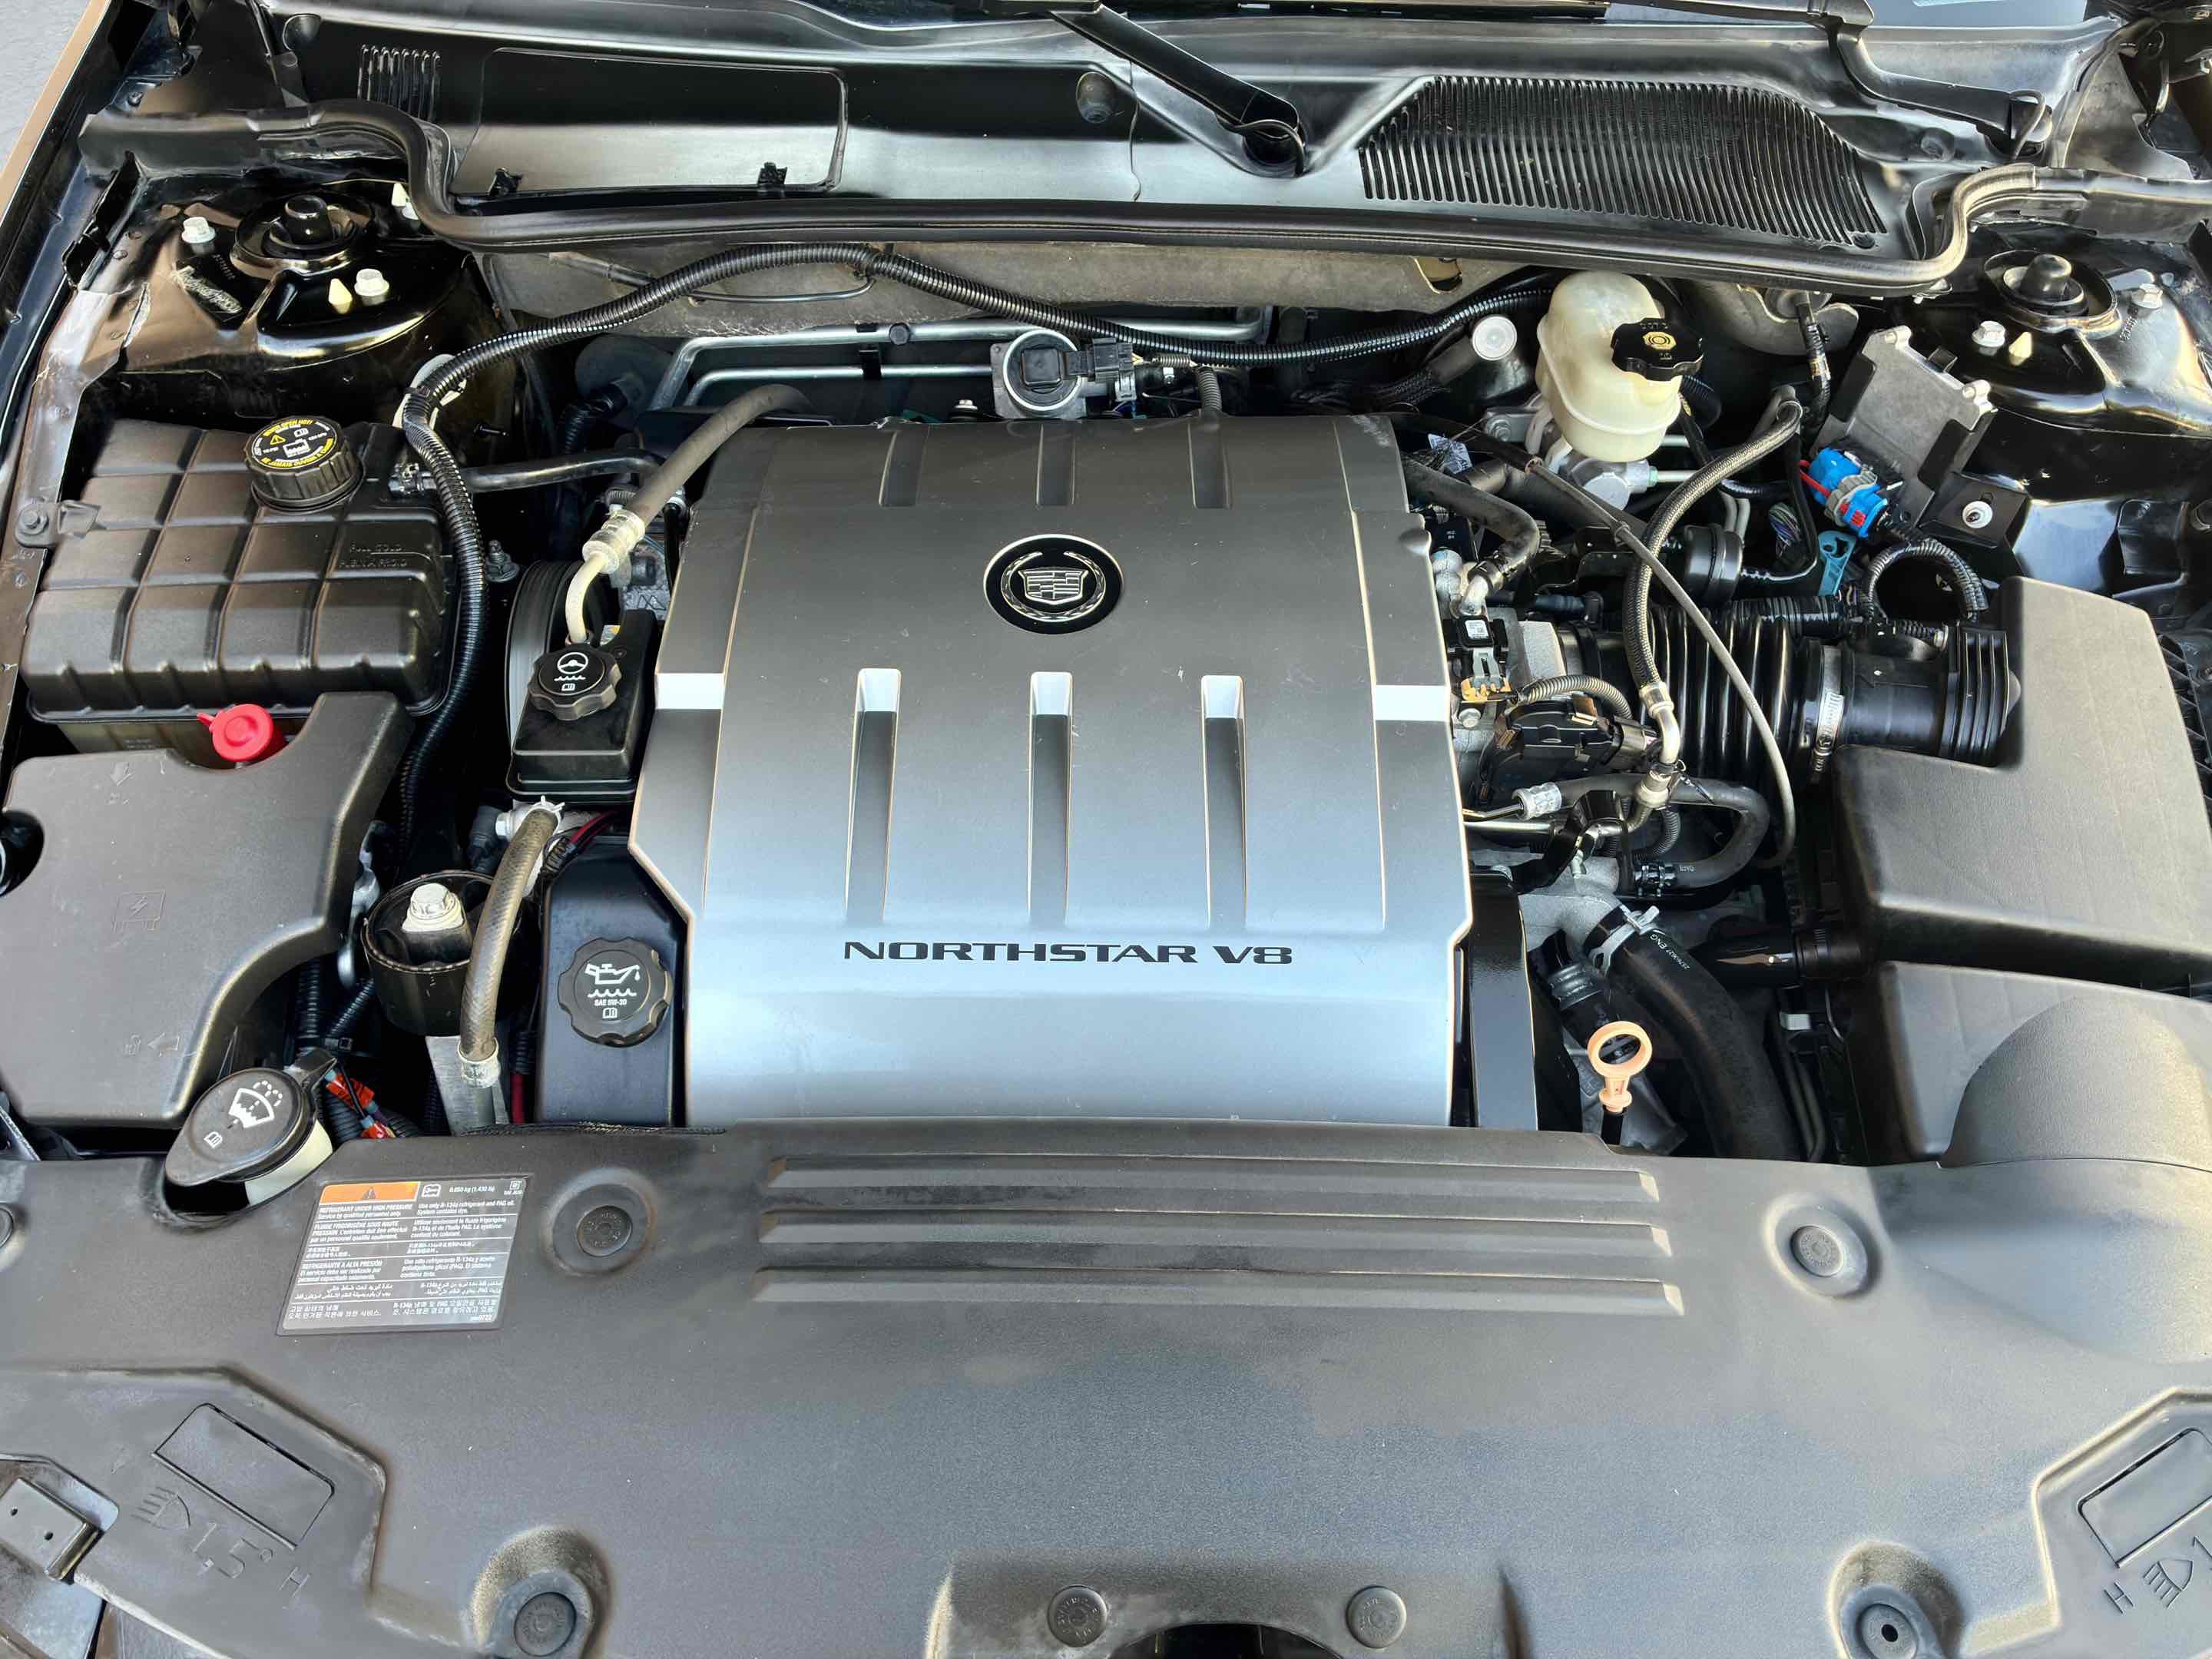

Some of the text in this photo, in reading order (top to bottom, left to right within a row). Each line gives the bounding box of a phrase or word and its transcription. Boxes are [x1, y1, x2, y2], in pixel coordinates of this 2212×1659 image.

[843, 941, 1293, 965] NORTHSTAR V8
[607, 998, 628, 1006] 5W-30
[280, 1566, 311, 1598] H
[2103, 1581, 2135, 1614] H
